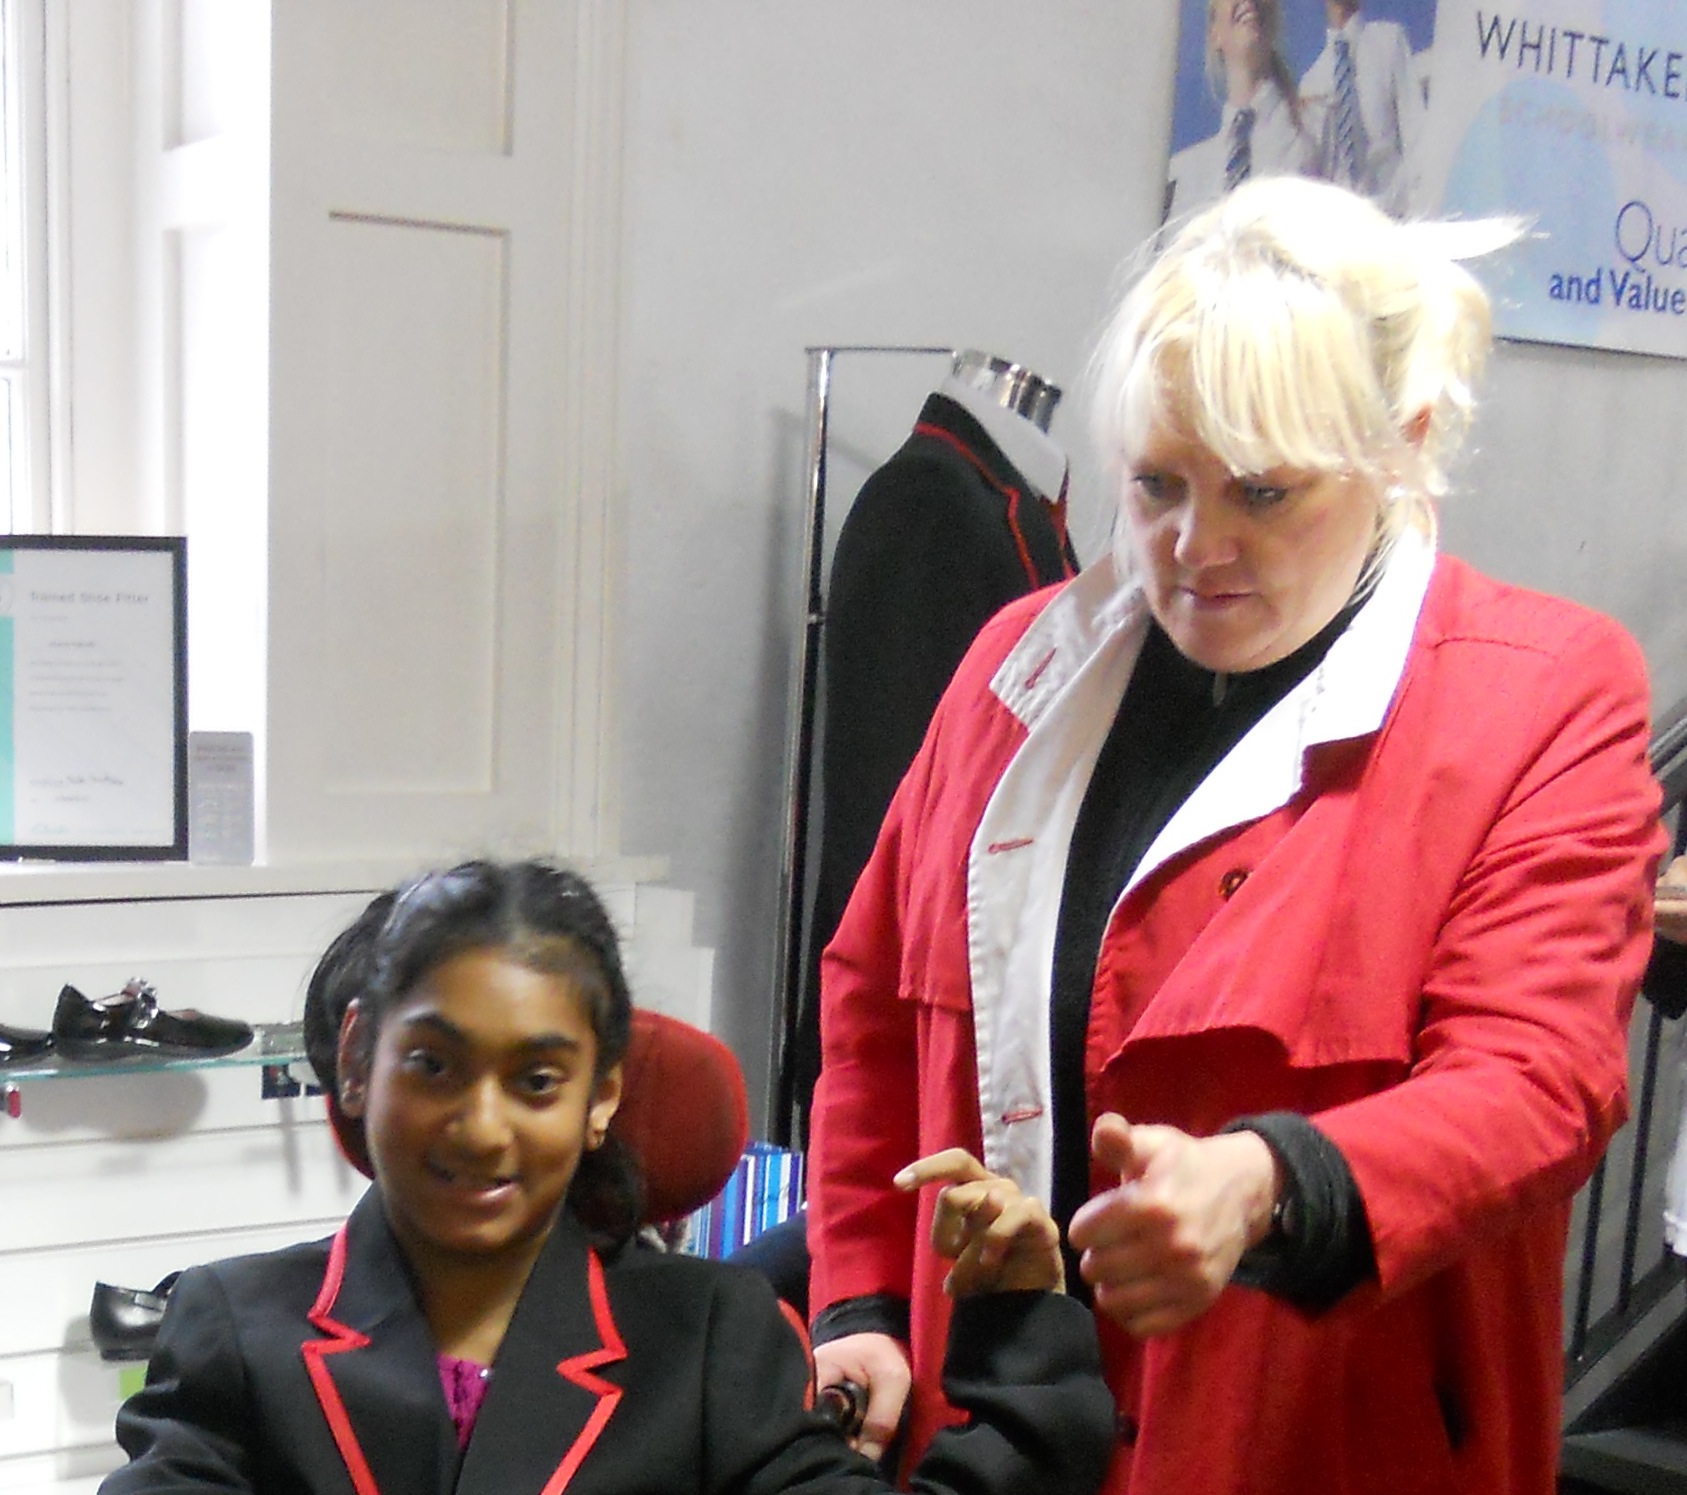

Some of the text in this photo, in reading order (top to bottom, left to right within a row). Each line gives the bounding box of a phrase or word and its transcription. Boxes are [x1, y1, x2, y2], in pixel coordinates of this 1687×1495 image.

[1476, 11, 1687, 100] WHITTAKE
[1549, 266, 1687, 315] and Value
